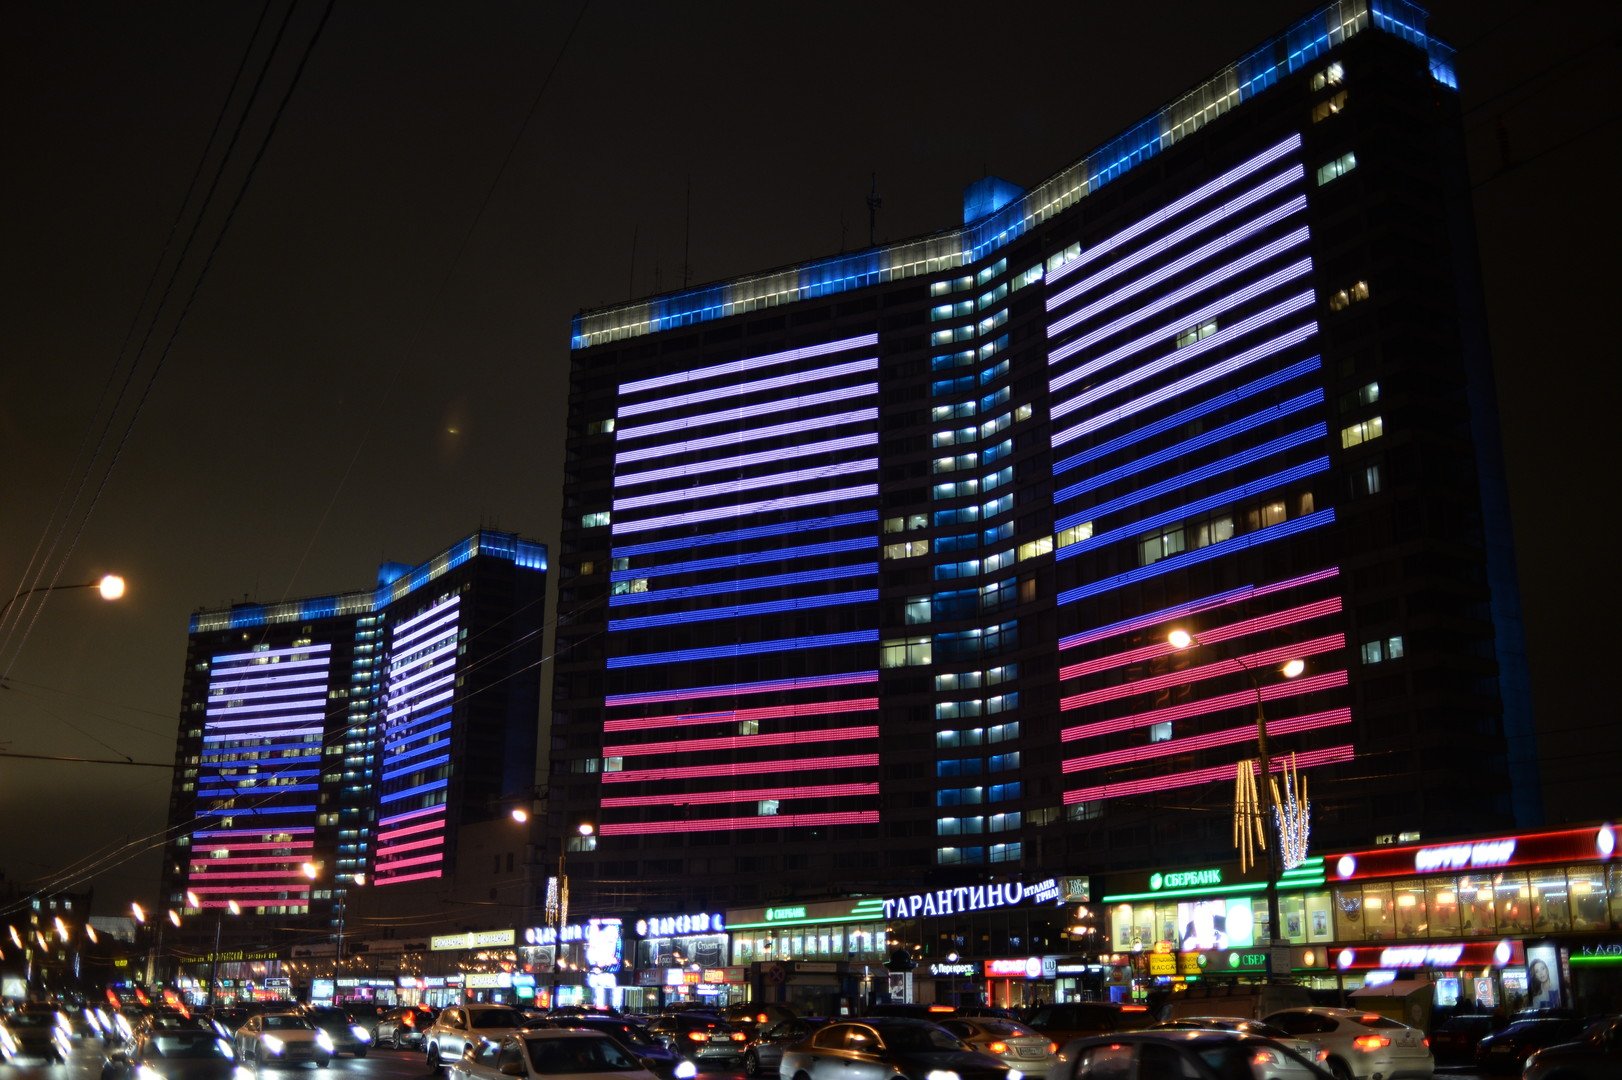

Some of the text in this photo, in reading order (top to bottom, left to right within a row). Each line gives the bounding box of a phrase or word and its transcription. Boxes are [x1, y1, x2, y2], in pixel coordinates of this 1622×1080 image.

[1164, 869, 1221, 887] СБЕРБАНК
[883, 882, 1023, 919] ТАРАНТИНО
[774, 906, 806, 920] СБЕРБАНК
